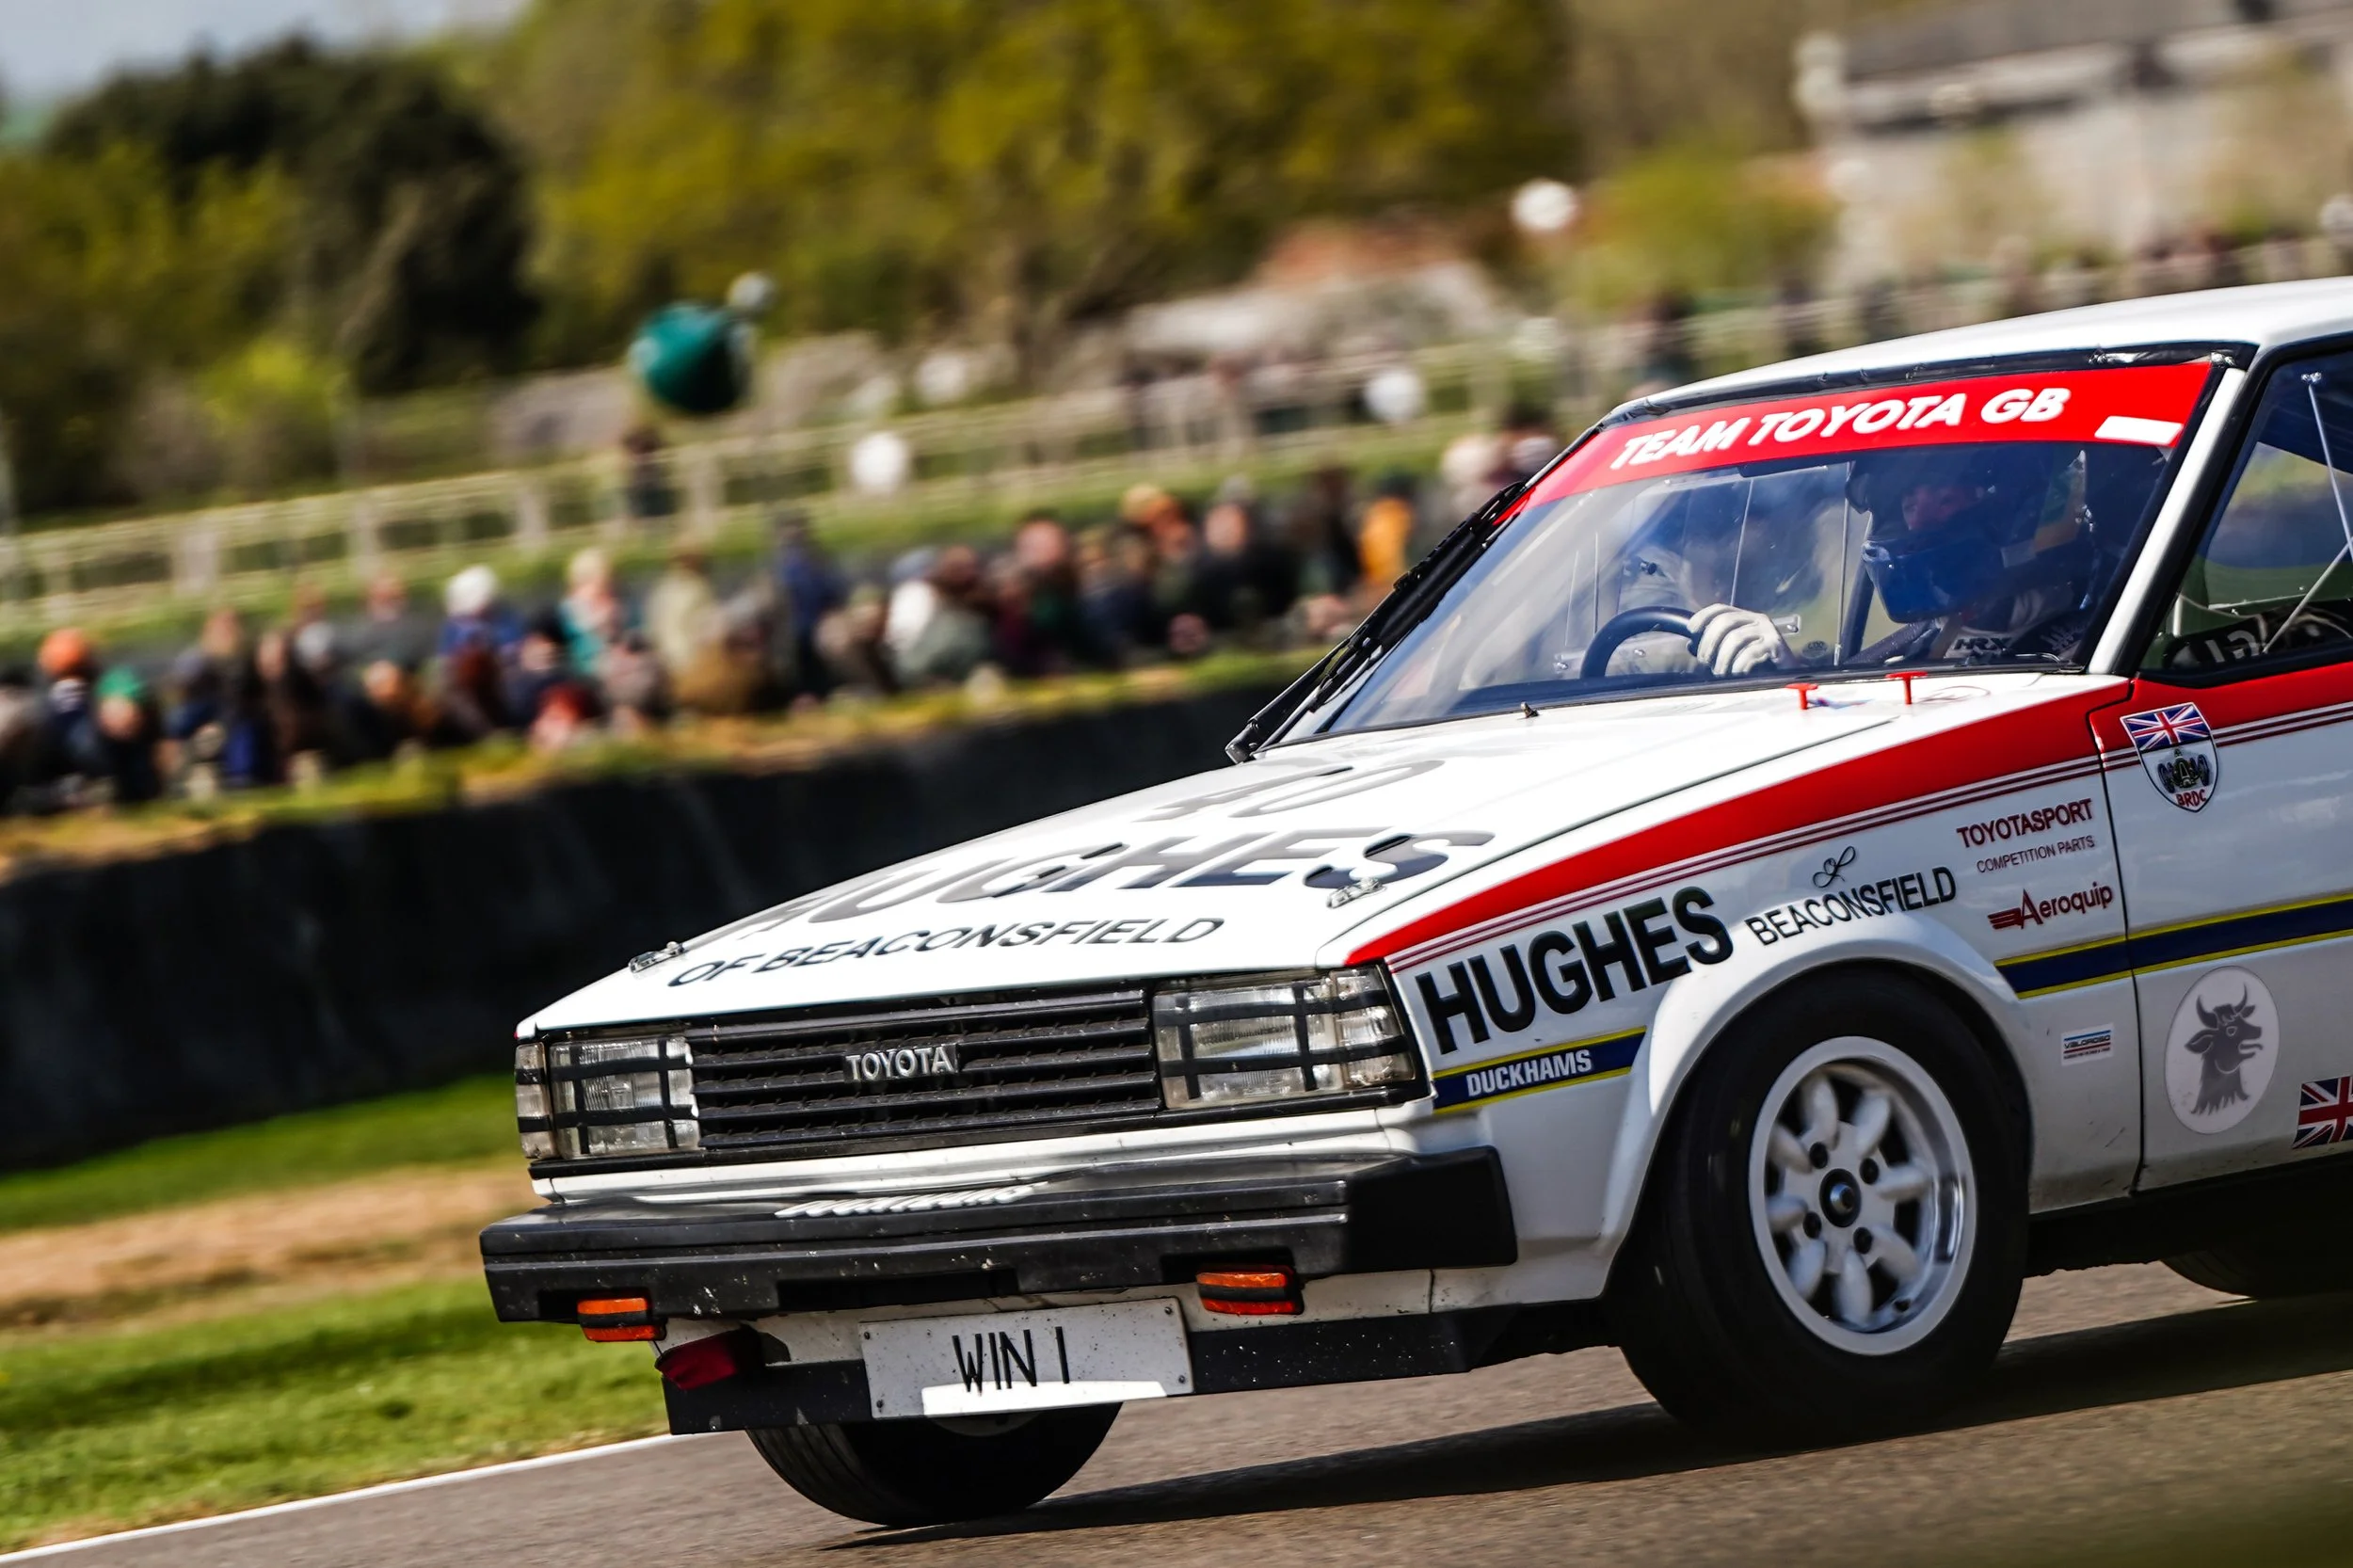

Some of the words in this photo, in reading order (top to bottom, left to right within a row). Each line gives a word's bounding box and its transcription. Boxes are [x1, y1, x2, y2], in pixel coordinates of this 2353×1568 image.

[1609, 415, 1753, 470] TEAM
[1748, 392, 1967, 447] TOYOTA
[1980, 387, 2071, 424] GB
[1957, 797, 2094, 848] TOYOTASPORT
[2176, 789, 2207, 808] BRDC
[1976, 844, 2057, 874] COMPETITION
[2057, 834, 2096, 857] PARTS
[685, 825, 1495, 952] HUGHES
[2014, 881, 2114, 930] Aeroquip
[667, 952, 767, 987] OF
[750, 918, 1225, 974] BEACONSFIELD
[1415, 886, 1735, 1055] HUGHES
[1744, 866, 1957, 946] BEACONSFIELD
[845, 1045, 954, 1081] TOYOTA
[1465, 1048, 1593, 1098] DUCKHAMS
[952, 1328, 1037, 1397] WIN
